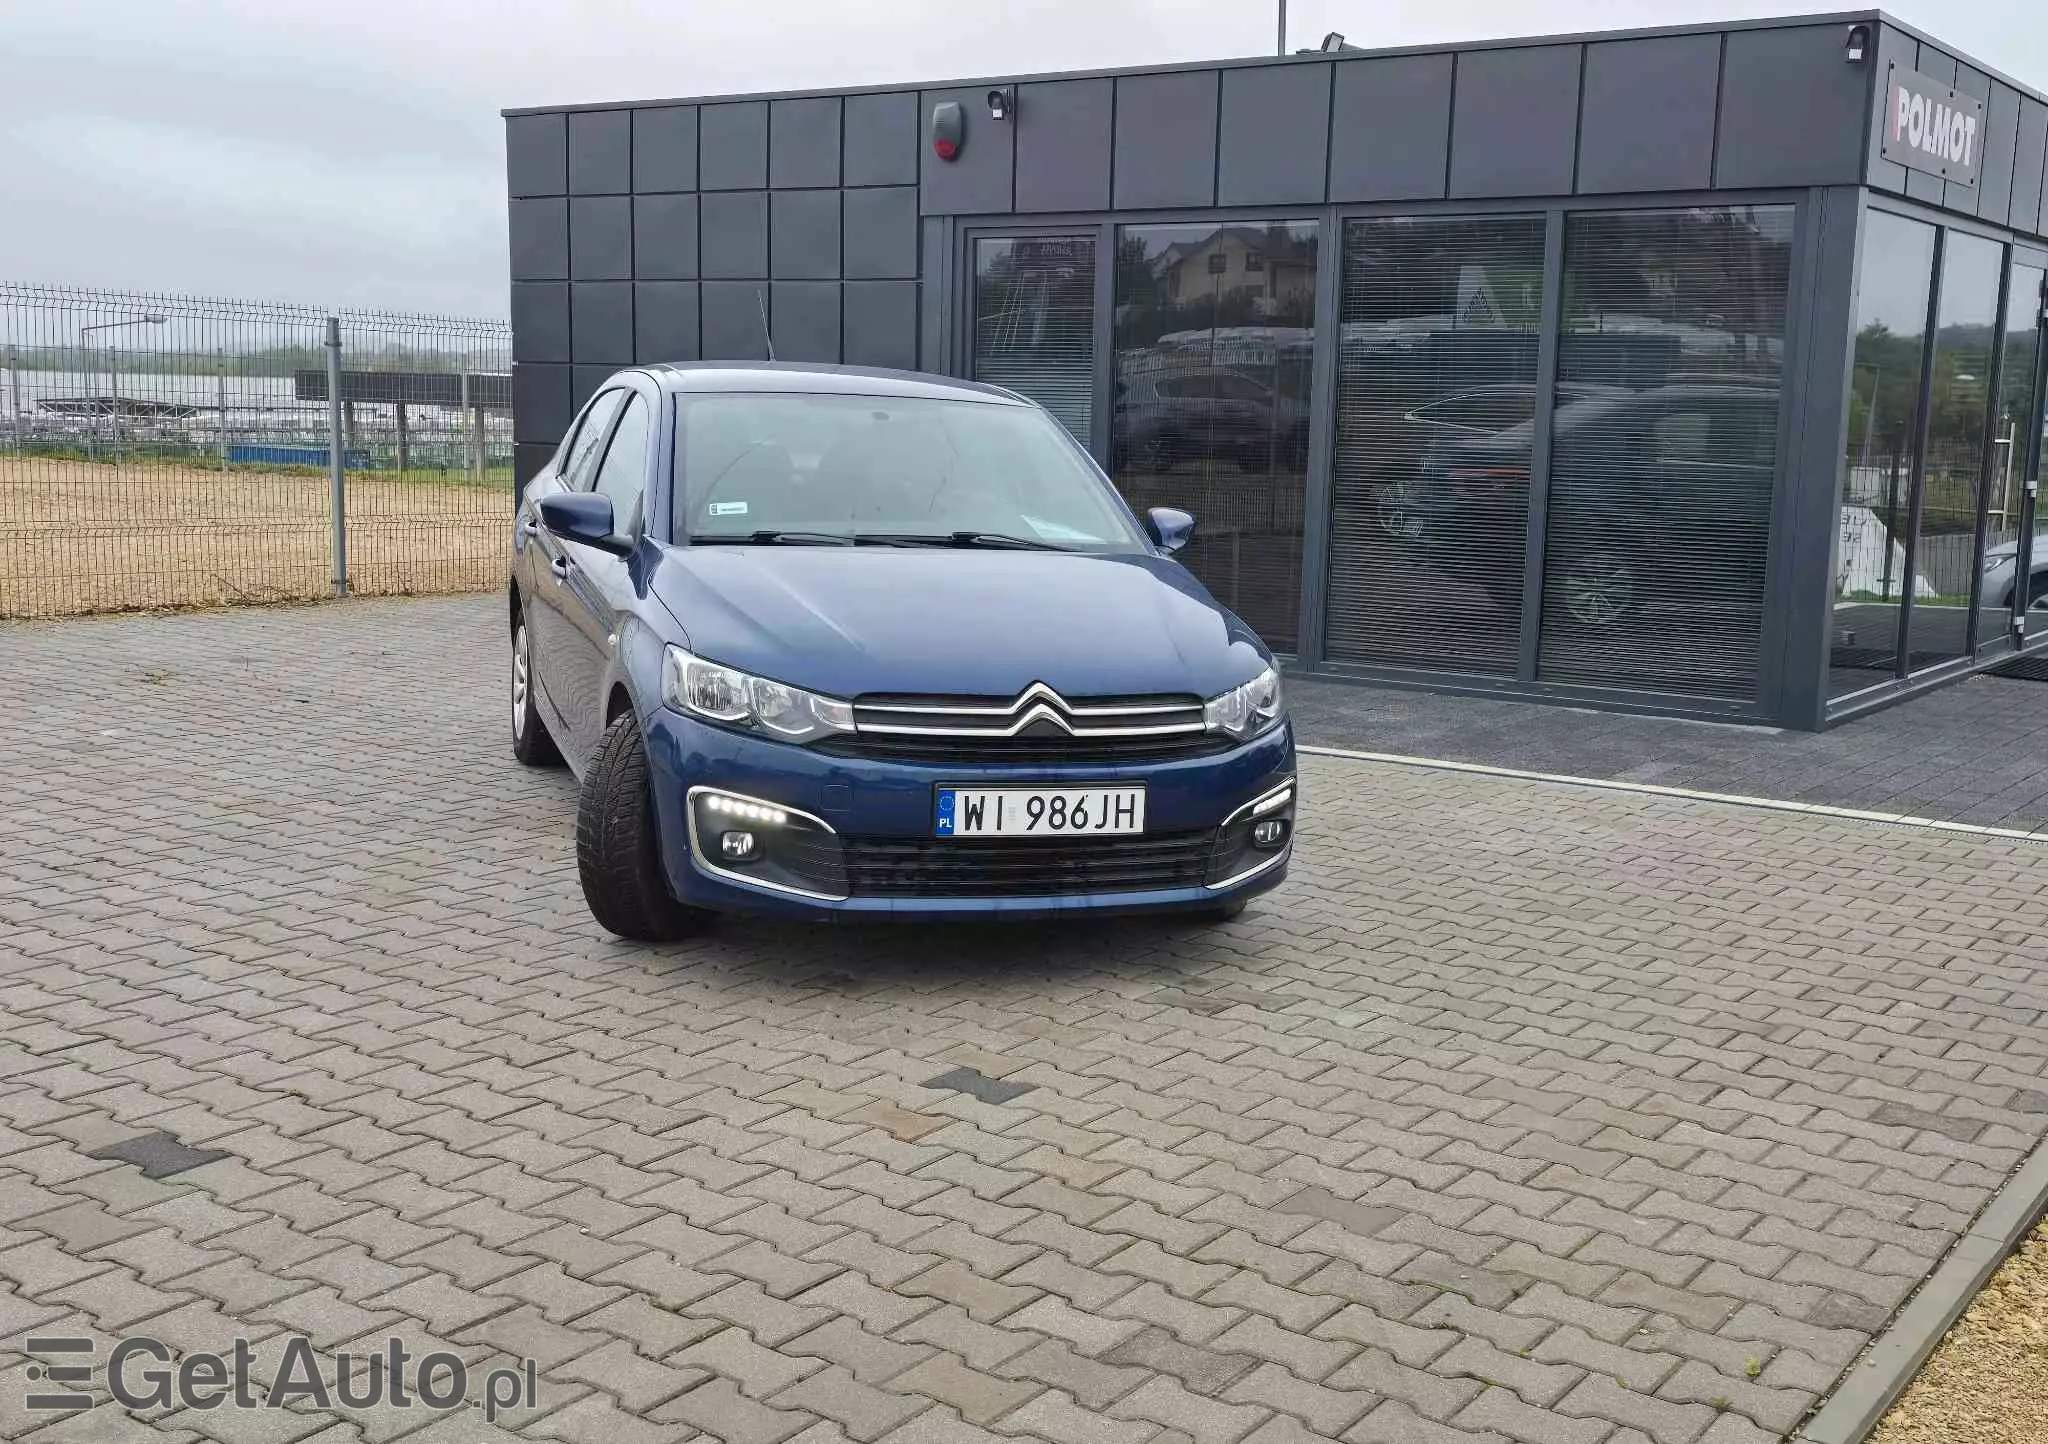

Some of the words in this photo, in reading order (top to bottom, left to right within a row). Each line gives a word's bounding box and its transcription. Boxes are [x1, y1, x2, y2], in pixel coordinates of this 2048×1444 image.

[1892, 85, 1976, 167] POLMOT
[939, 818, 953, 828] PL
[963, 795, 1003, 831] WI
[1026, 793, 1136, 831] 986JH
